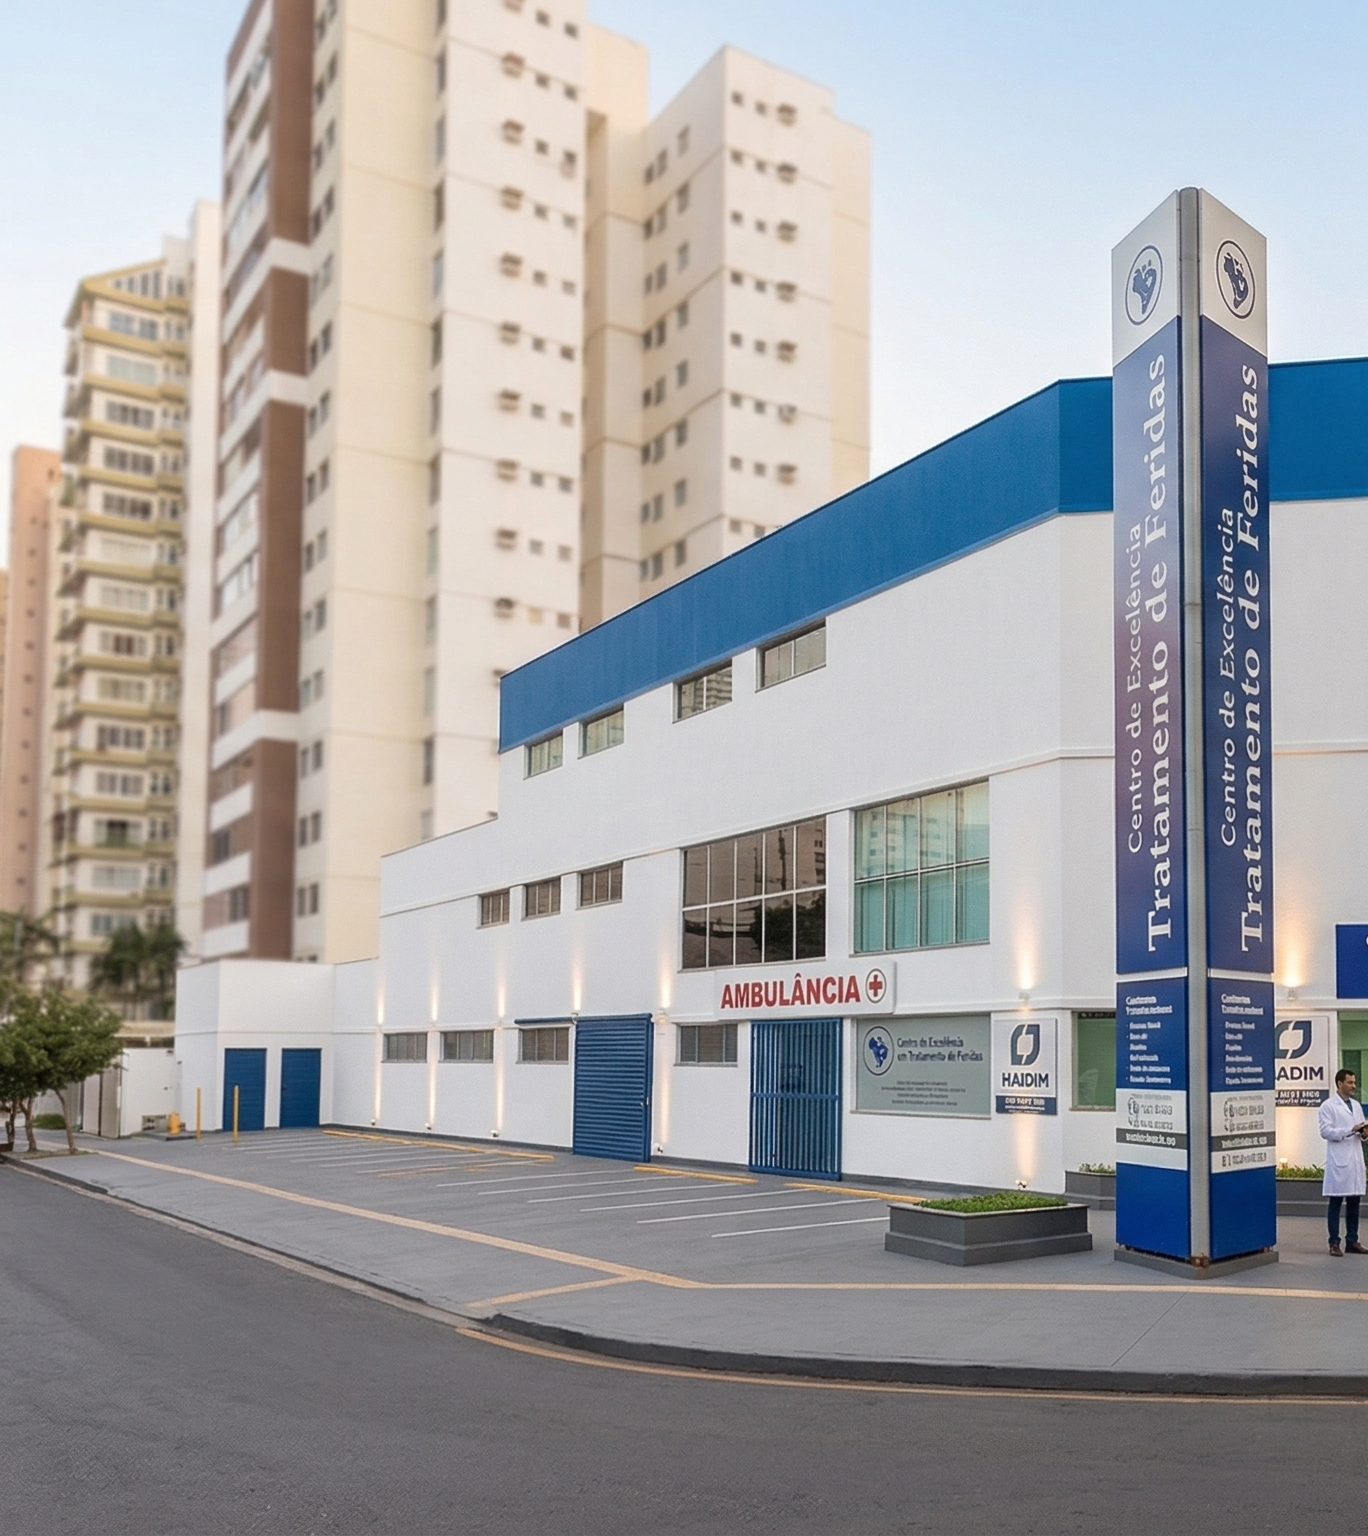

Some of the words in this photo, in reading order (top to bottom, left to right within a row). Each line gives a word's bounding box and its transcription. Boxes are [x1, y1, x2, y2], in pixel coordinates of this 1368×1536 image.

[1143, 353, 1167, 549] Feridas
[1235, 363, 1260, 552] Feridas
[1125, 523, 1142, 694] Excelência
[1145, 561, 1168, 624] de
[1217, 508, 1235, 682] Excelência
[1238, 568, 1261, 631] de
[1125, 702, 1142, 740] de
[1218, 690, 1235, 729] de
[1127, 747, 1143, 854] Centro
[1147, 640, 1172, 953] Tratamento
[1220, 738, 1237, 848] Centro
[1240, 647, 1263, 953] Tratamento
[720, 972, 861, 1010] AMBULÂNCIA
[1002, 1072, 1049, 1088] HAIDIM
[1275, 1066, 1324, 1081] ADIM
